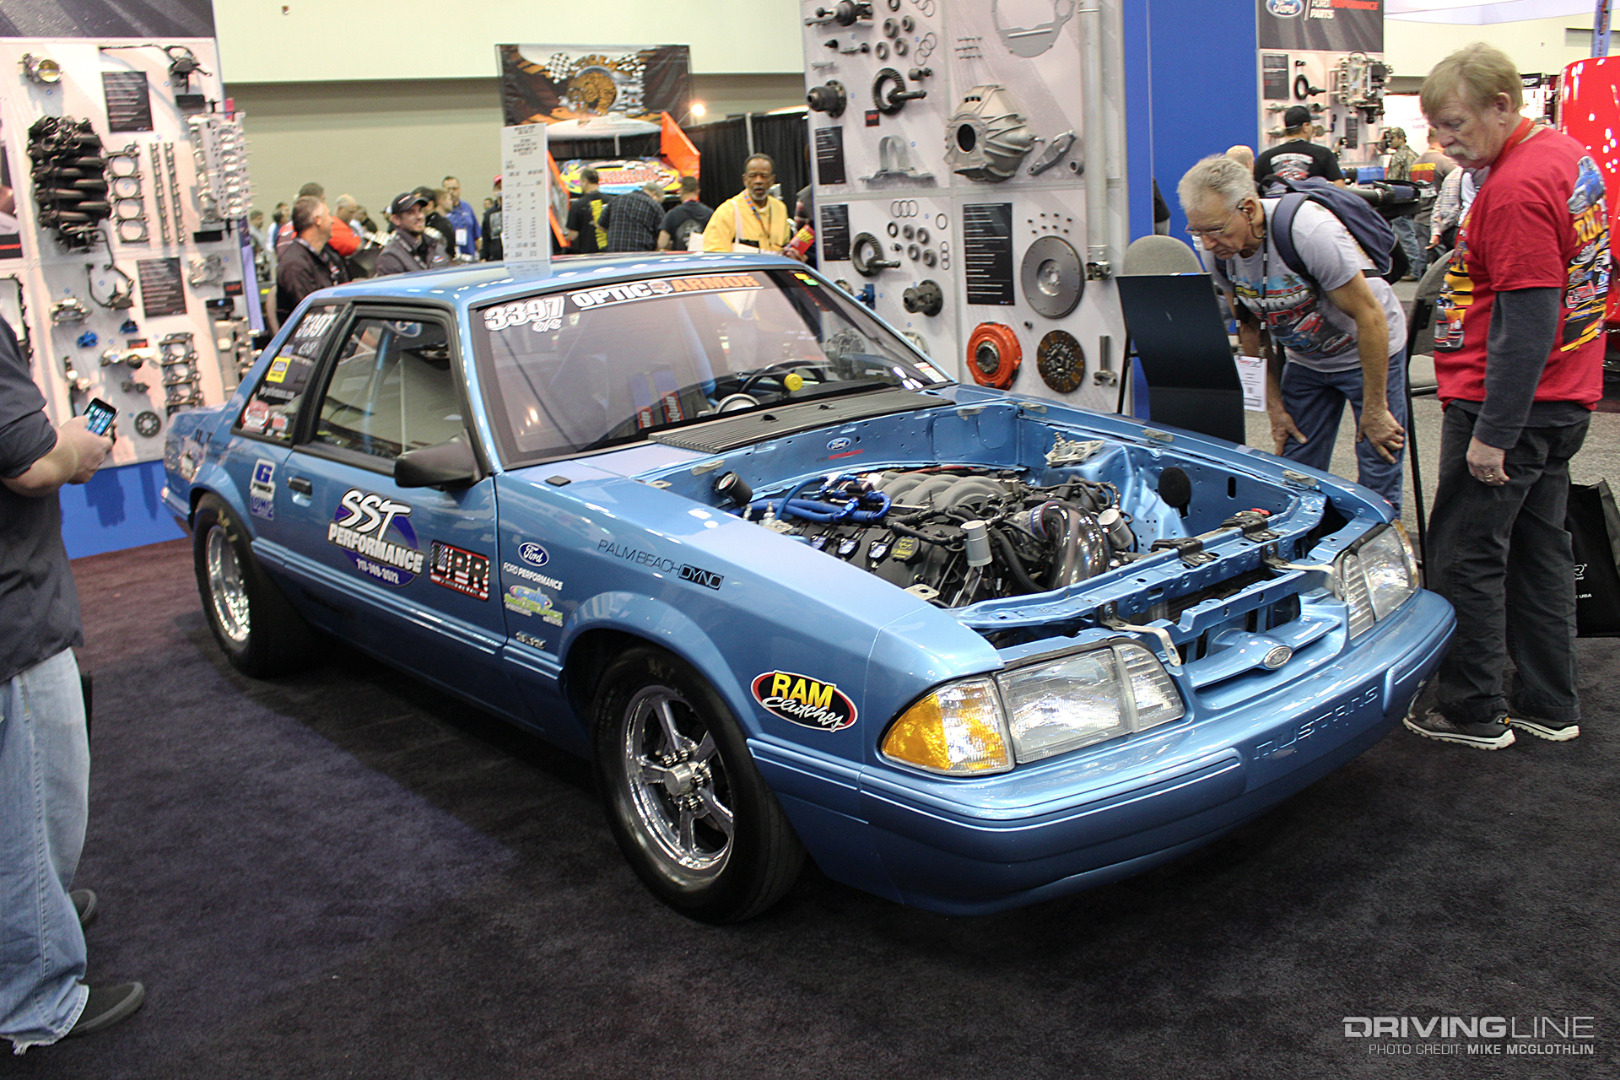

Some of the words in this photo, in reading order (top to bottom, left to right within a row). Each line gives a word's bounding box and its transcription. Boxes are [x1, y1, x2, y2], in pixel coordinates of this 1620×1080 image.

[571, 282, 651, 308] OPTIC
[671, 275, 761, 292] ARMOR
[295, 313, 338, 338] 3397
[485, 295, 566, 331] 3397
[338, 489, 412, 541] SST
[328, 522, 424, 575] PERFORMANCE
[523, 544, 545, 563] Ford
[597, 539, 637, 561] PALM
[635, 551, 681, 577] BEACH
[679, 564, 724, 590] DYNO
[503, 562, 520, 575] FORD
[517, 567, 564, 591] PERFORMANCE
[771, 672, 835, 712] RAM
[762, 697, 846, 731] Clutches
[1253, 686, 1378, 760] MUSTANG
